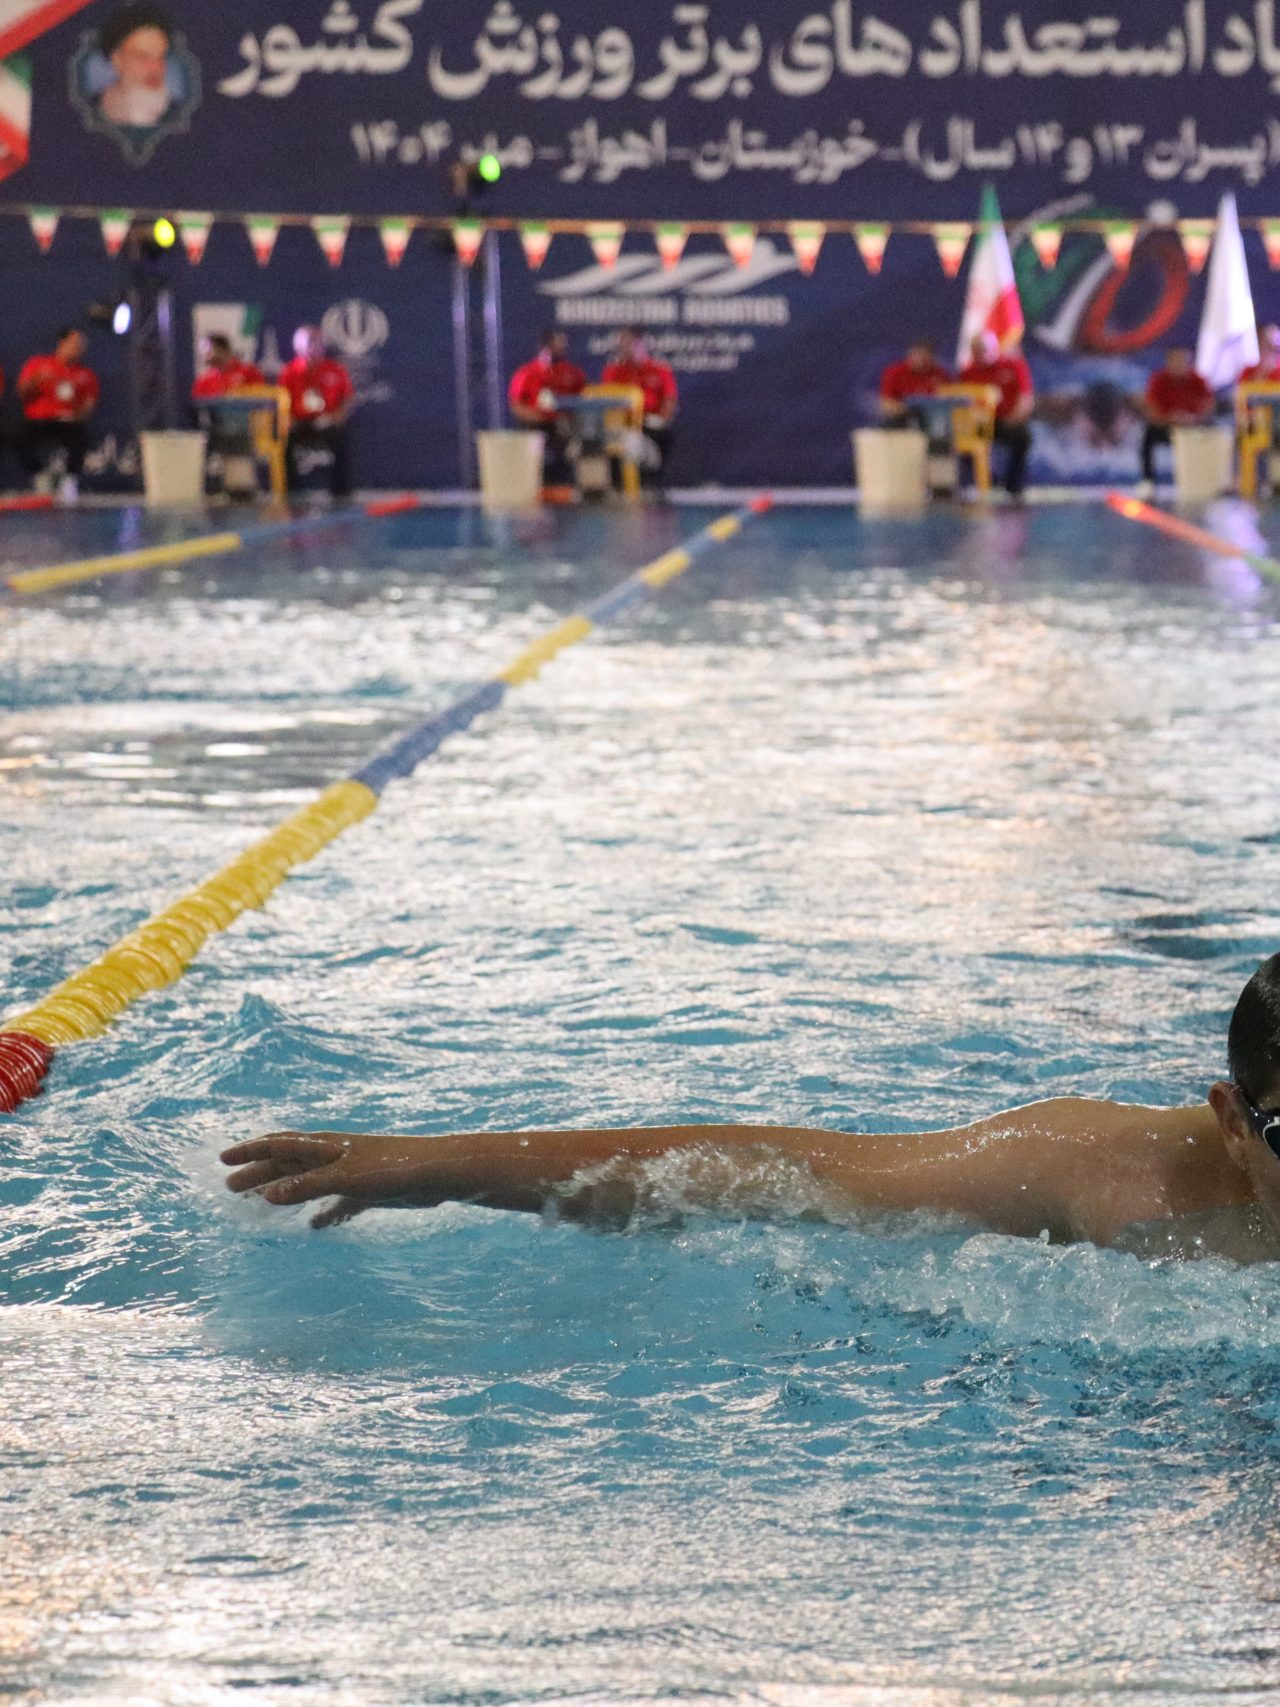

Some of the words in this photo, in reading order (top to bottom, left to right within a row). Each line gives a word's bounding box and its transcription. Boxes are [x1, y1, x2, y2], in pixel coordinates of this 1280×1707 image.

[217, 0, 424, 97] کشور
[428, 2, 635, 98] ورزش
[637, 3, 763, 98] برتر
[1063, 136, 1094, 184] و
